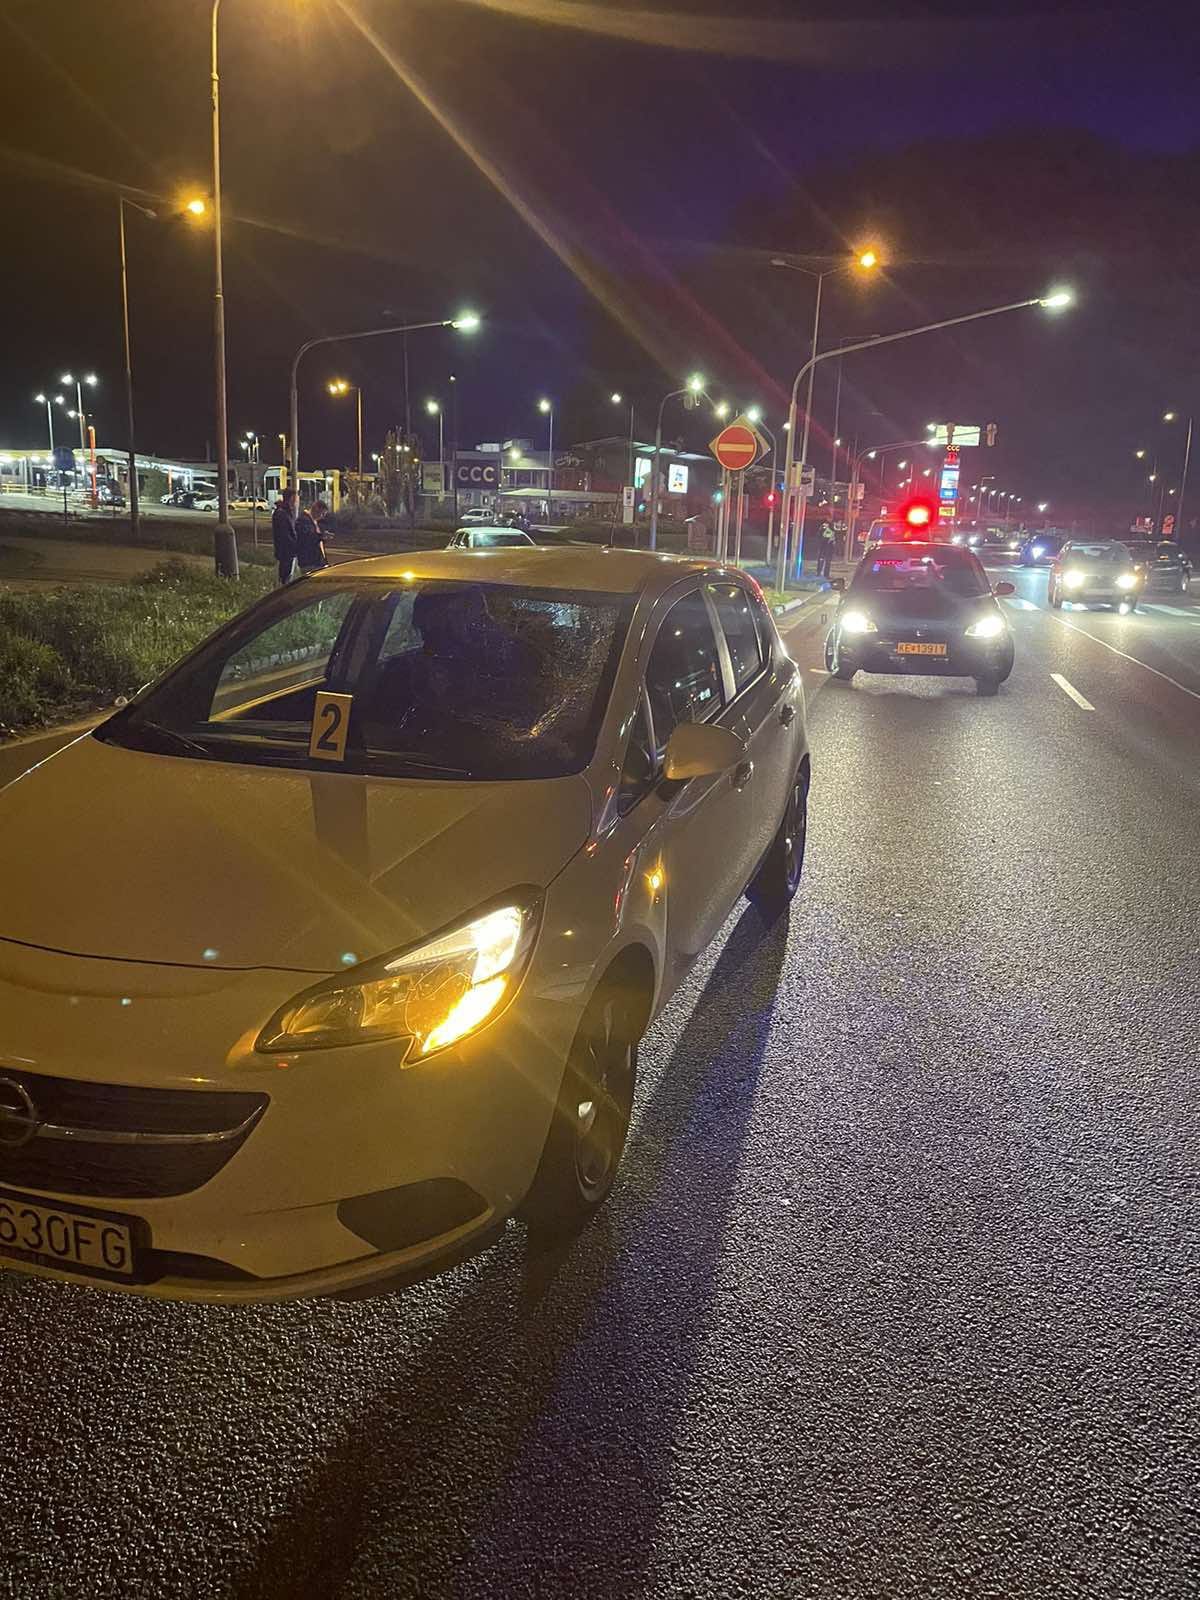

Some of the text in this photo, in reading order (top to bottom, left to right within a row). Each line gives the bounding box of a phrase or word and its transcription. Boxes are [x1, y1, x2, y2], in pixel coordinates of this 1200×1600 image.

[458, 466, 495, 482] CCC
[316, 703, 342, 751] 2
[0, 1202, 126, 1268] 630FG
